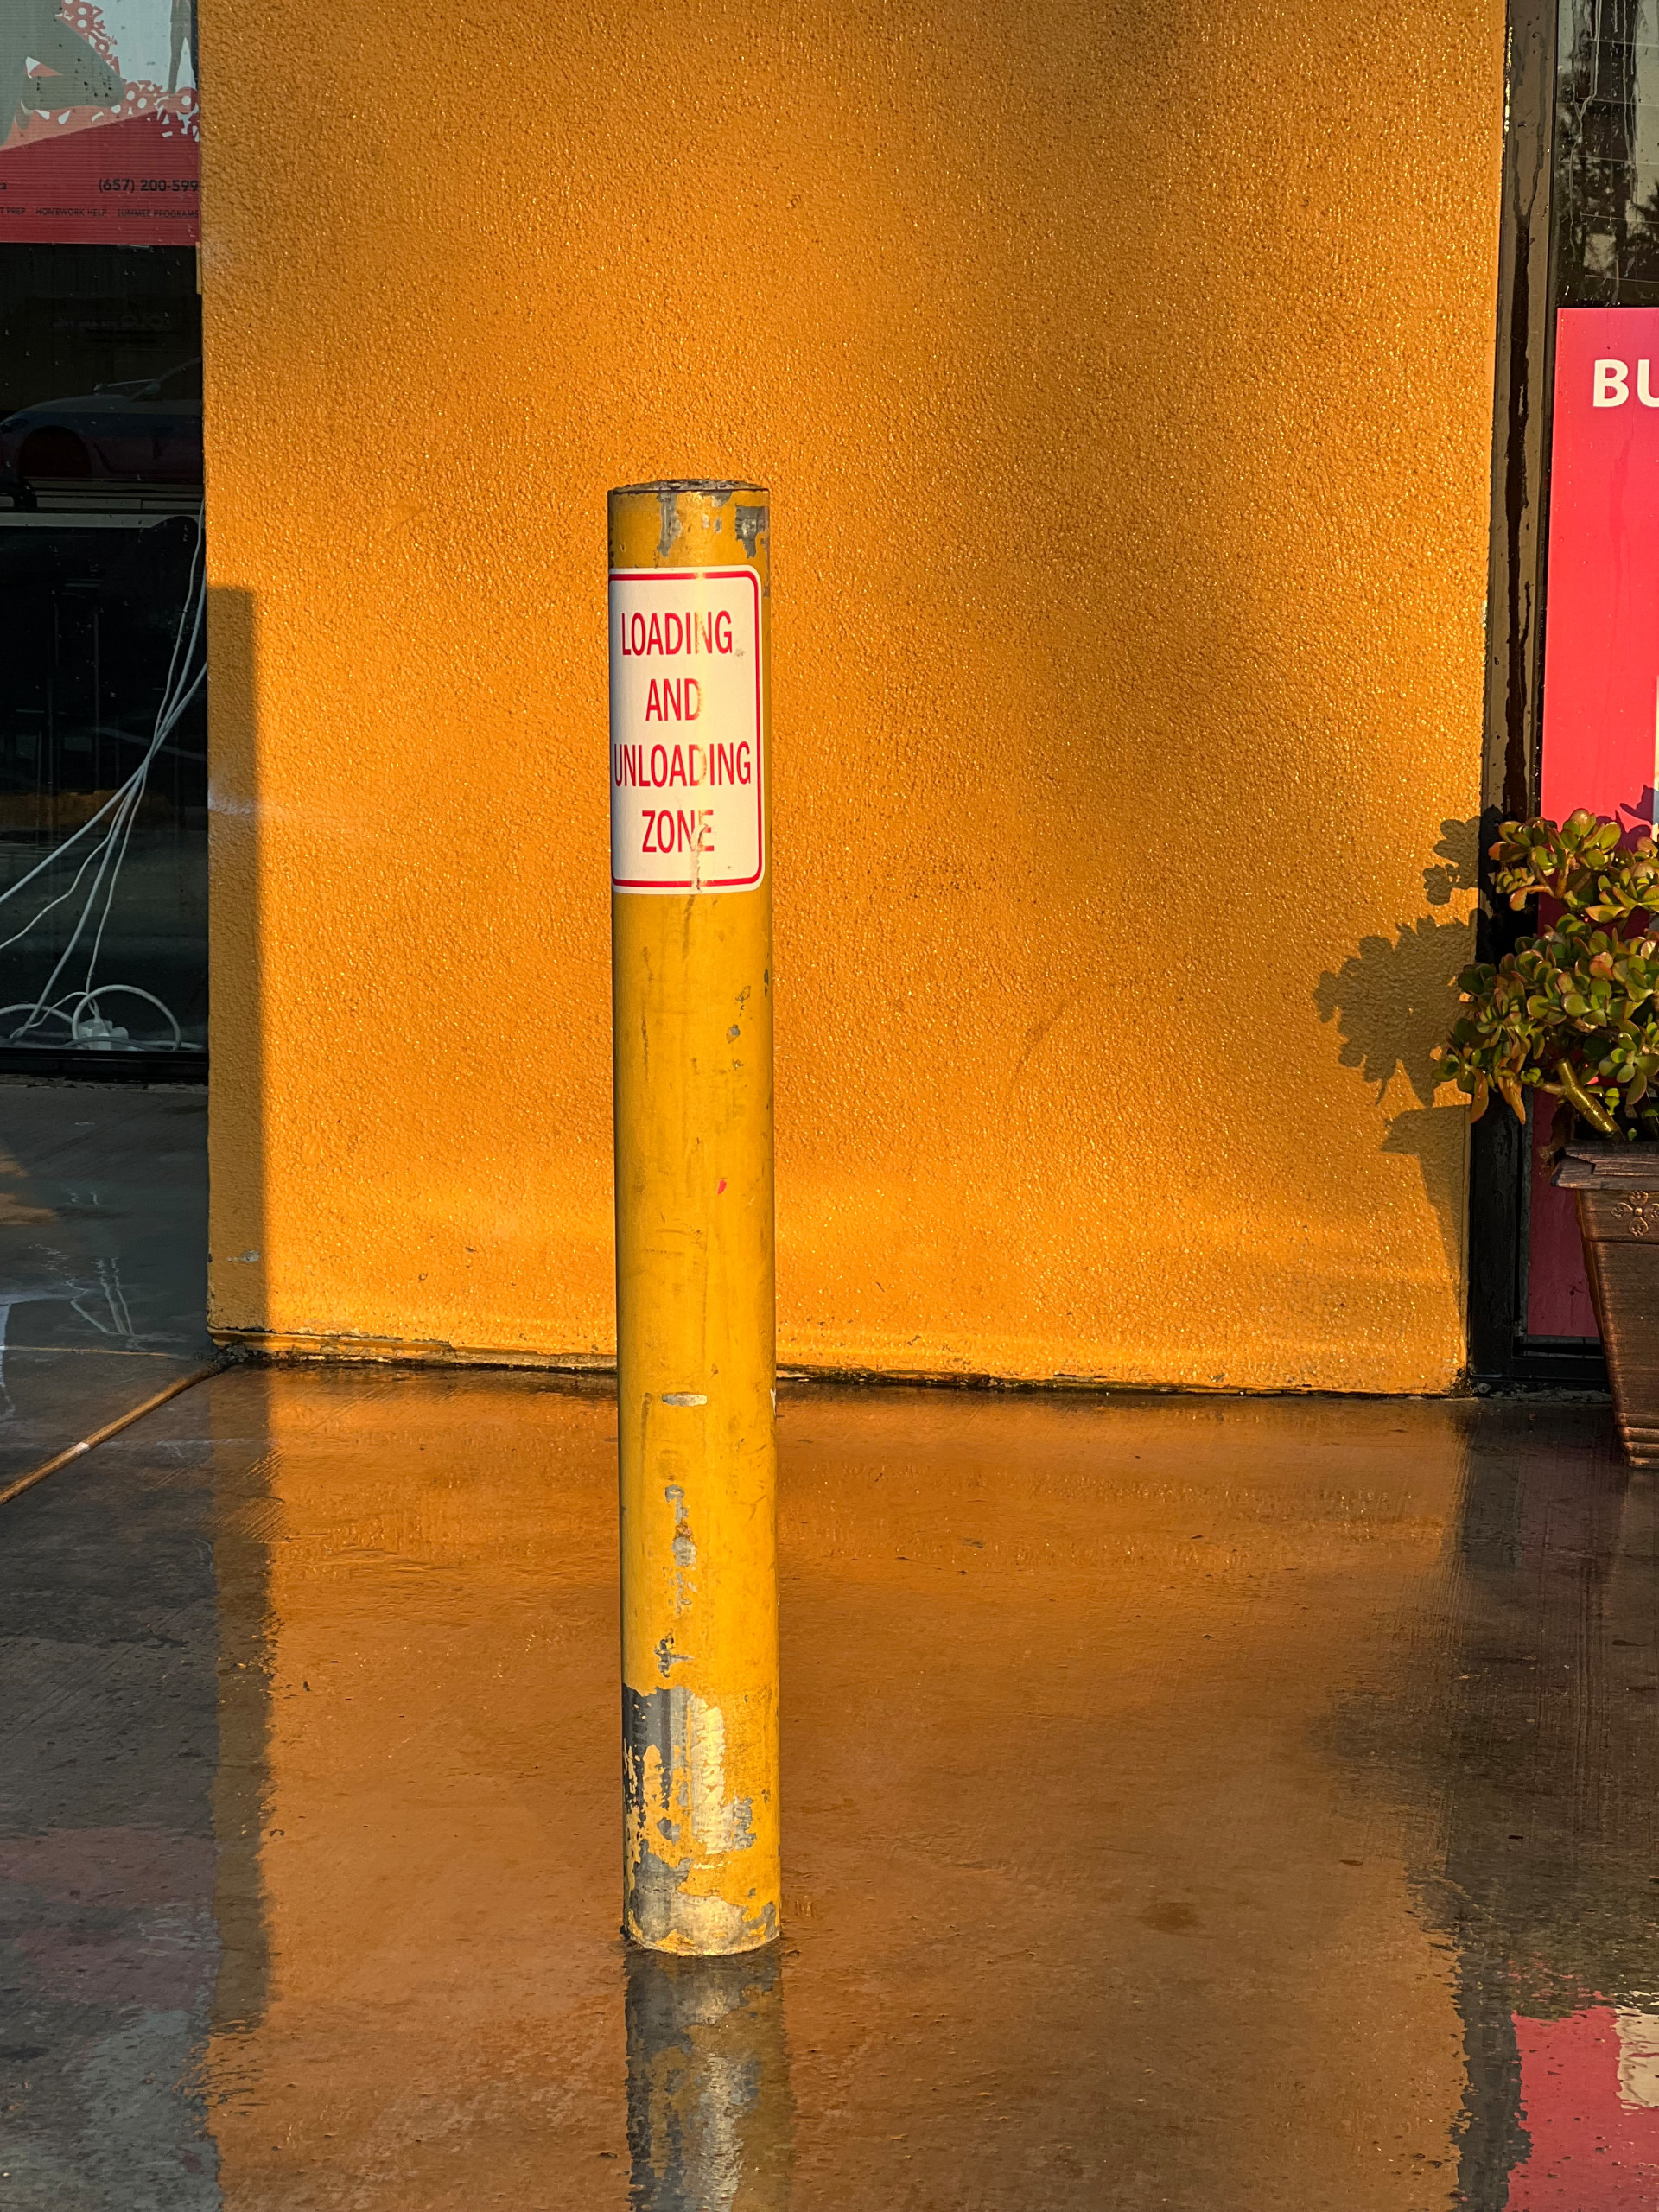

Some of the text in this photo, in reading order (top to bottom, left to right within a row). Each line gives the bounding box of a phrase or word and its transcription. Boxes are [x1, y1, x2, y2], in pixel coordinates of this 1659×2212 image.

[98, 178, 135, 194] (657)
[35, 207, 107, 217] HOMEWORK HELP
[117, 208, 199, 219] SUMMER PROGRAMS
[621, 610, 733, 656] LOADING
[645, 678, 702, 721] AND
[613, 741, 751, 787] UNLOADING
[641, 809, 715, 854] ZONE
